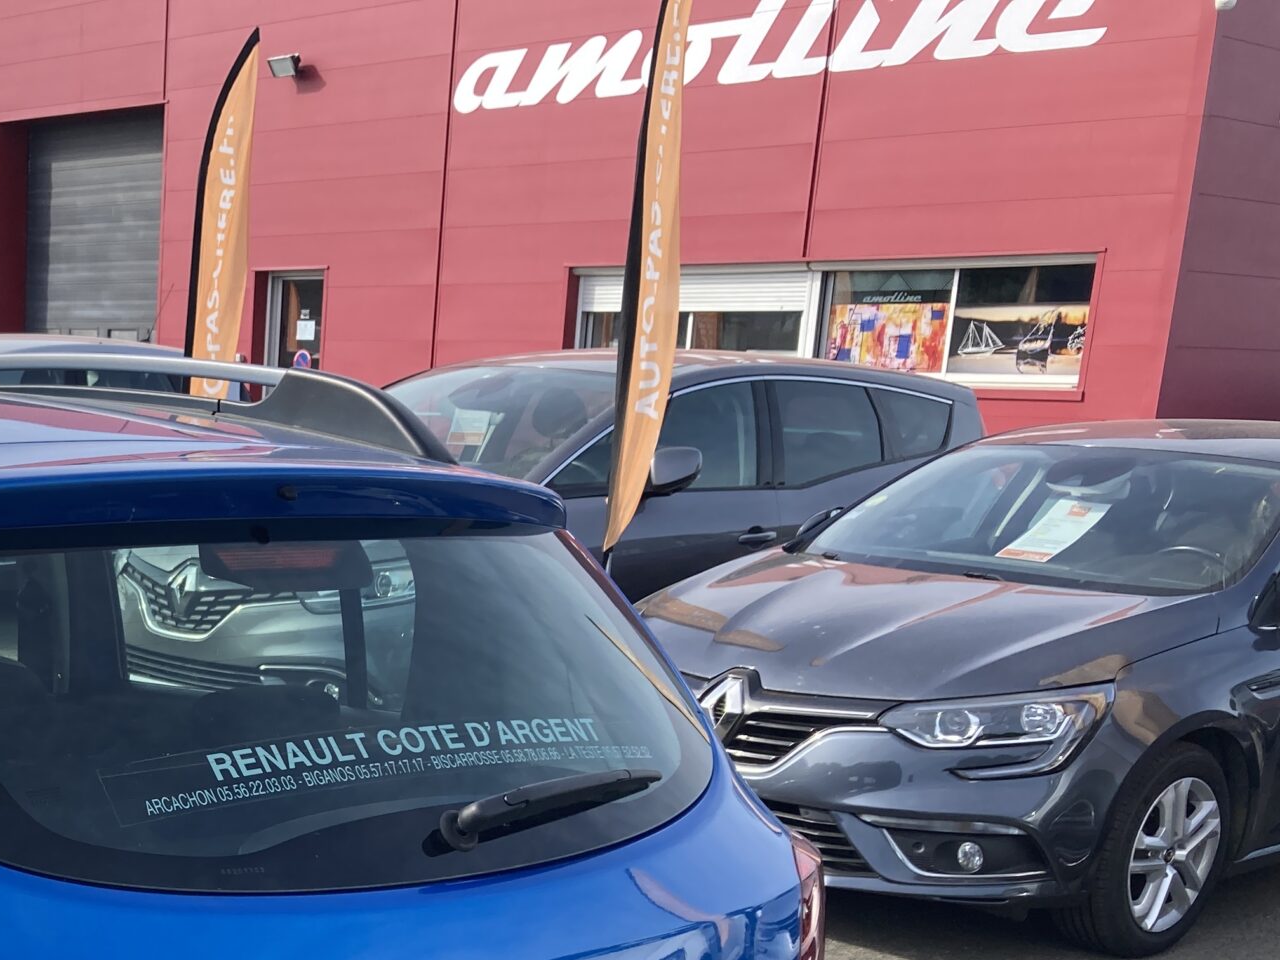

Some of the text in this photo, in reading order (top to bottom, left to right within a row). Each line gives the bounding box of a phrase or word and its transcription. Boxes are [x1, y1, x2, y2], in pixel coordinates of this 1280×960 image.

[145, 788, 218, 816] ARCACHON
[217, 775, 297, 802] 05.56.22.03.03
[303, 765, 356, 787] BIGANOS
[355, 757, 425, 779] 05.57.17.17.17
[431, 750, 502, 770] BISCARROSSE
[206, 731, 369, 781] RENAULT
[377, 724, 466, 757] COTE
